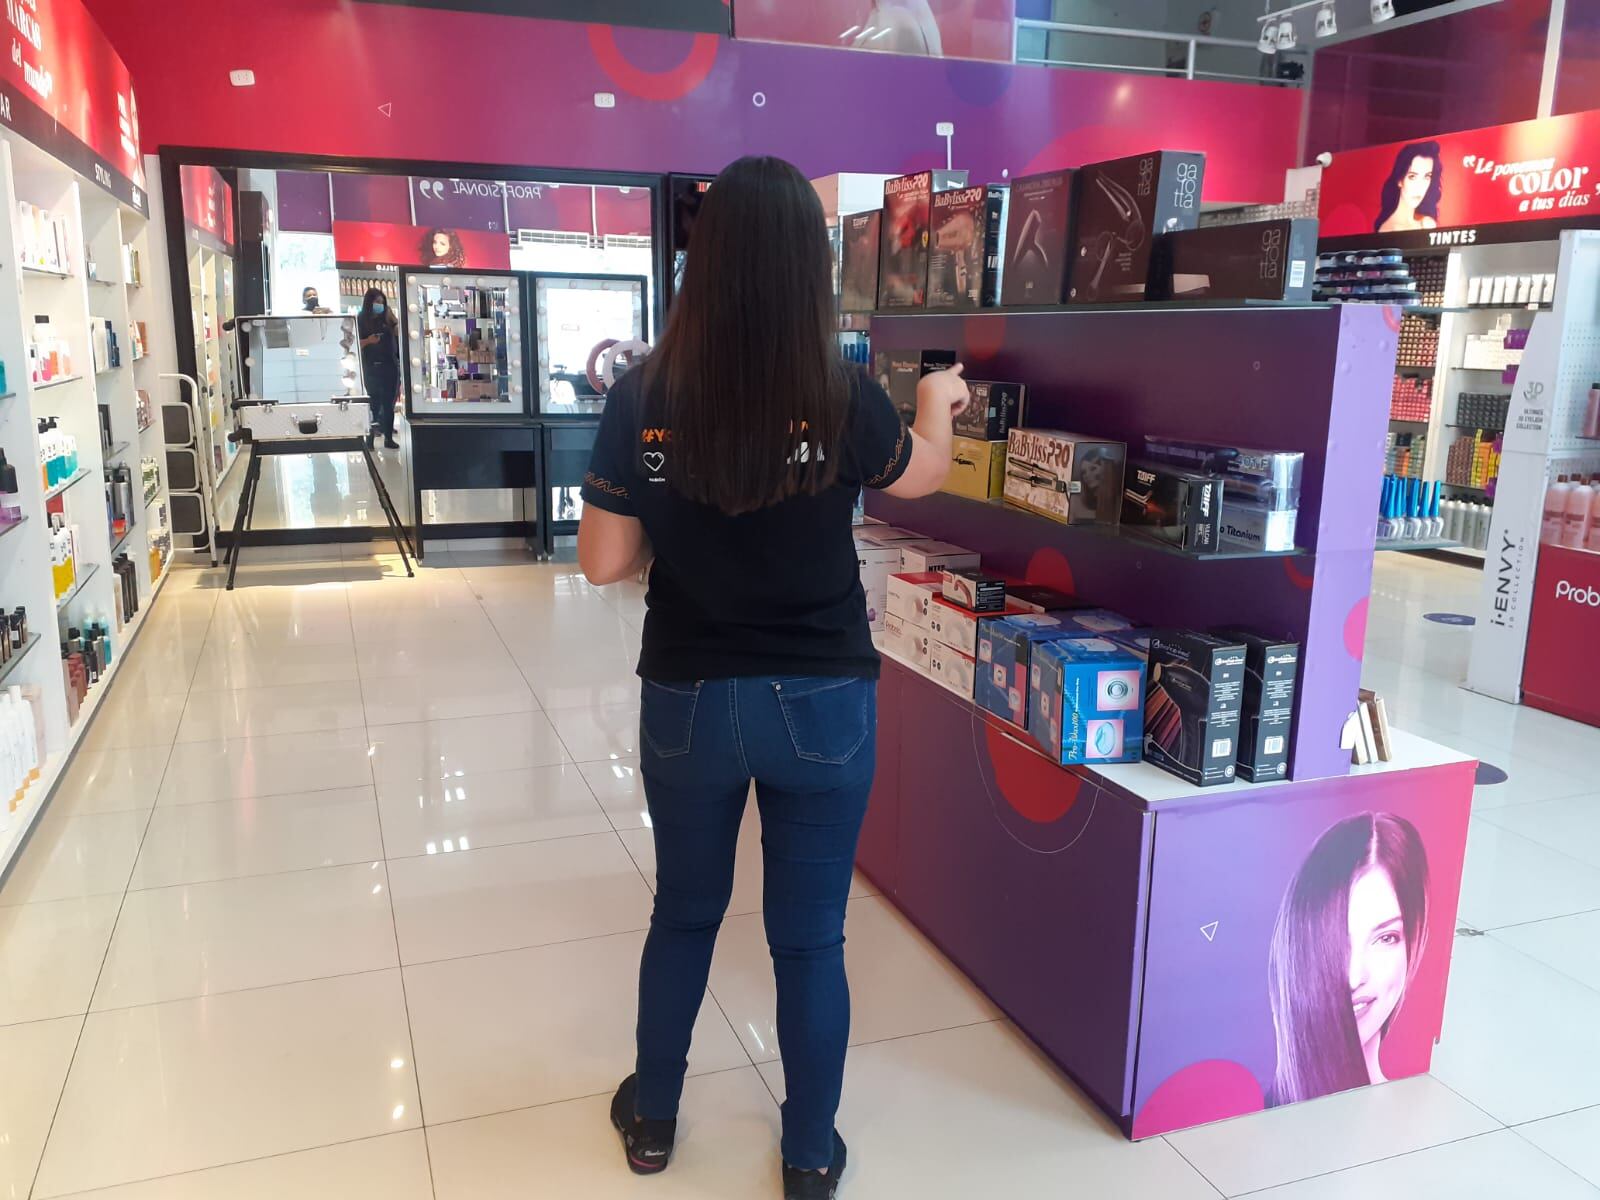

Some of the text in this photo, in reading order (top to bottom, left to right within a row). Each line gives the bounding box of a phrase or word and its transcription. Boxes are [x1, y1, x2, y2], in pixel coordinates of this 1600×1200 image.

[1532, 197, 1555, 211] tus
[1429, 229, 1477, 246] TINTES
[1226, 525, 1261, 543] Titanium
